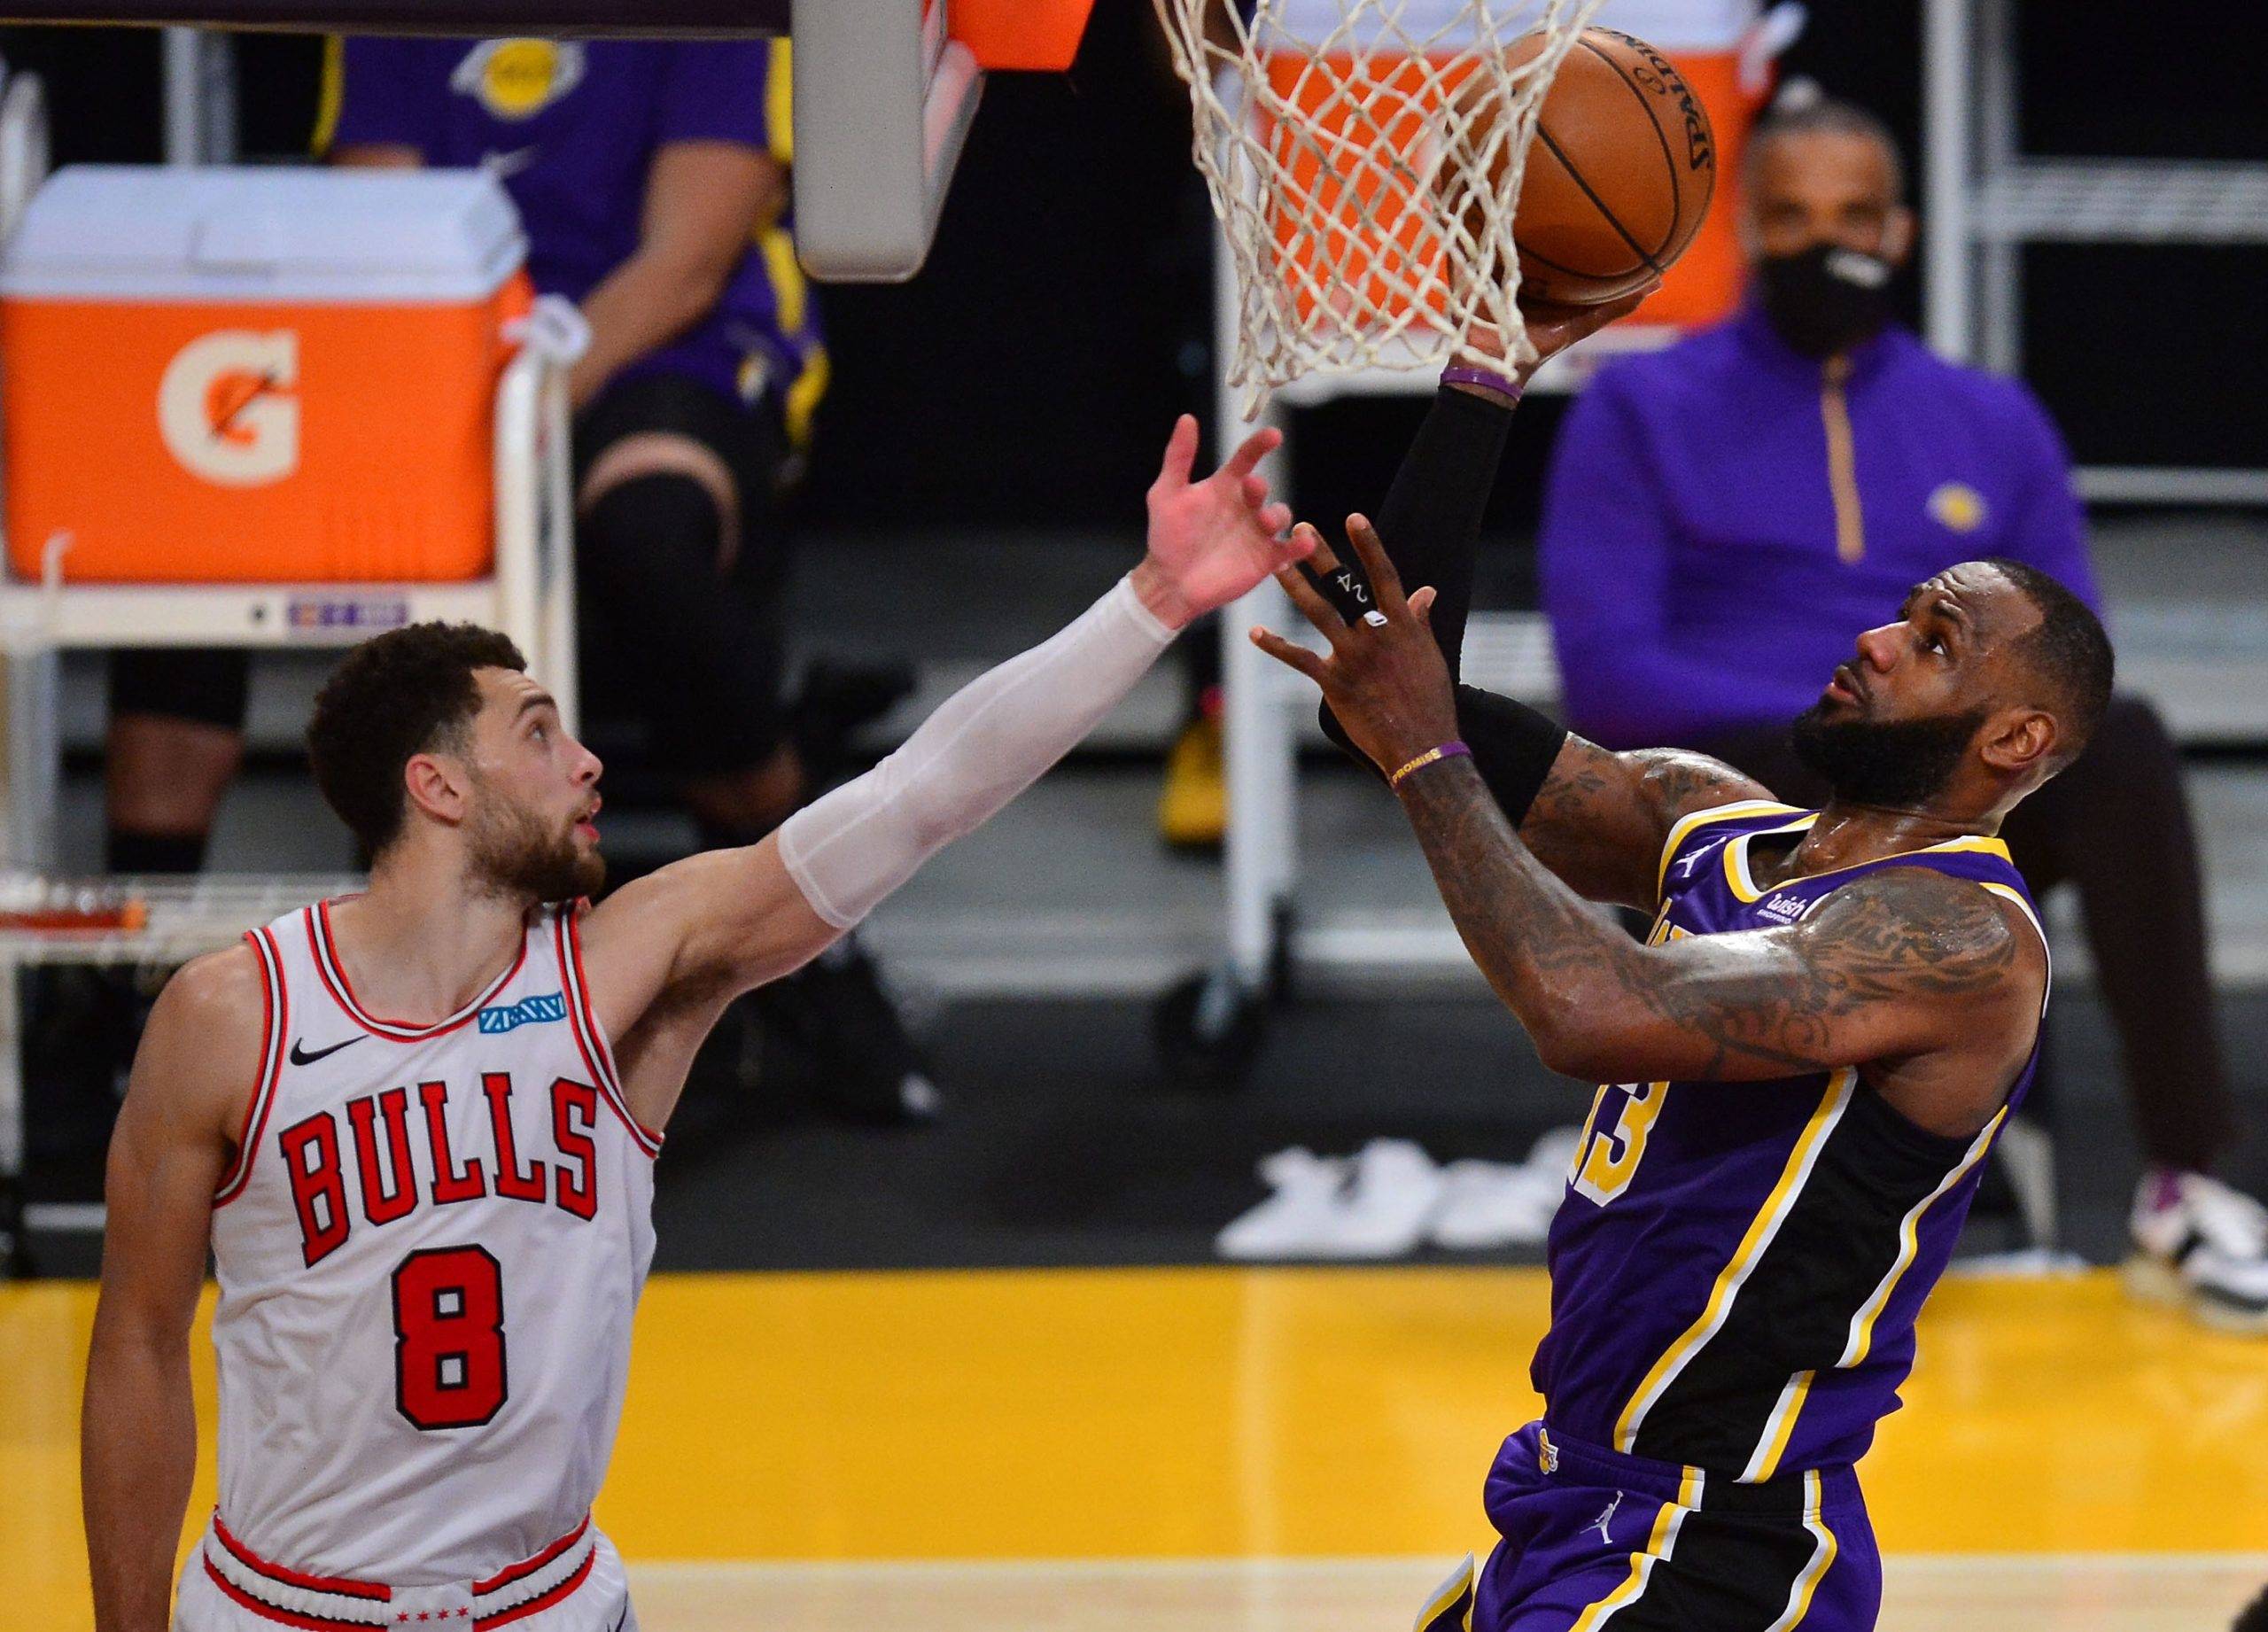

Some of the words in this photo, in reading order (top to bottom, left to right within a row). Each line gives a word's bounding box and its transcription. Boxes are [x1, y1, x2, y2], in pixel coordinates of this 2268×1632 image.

[157, 329, 300, 487] G
[278, 1072, 597, 1270] BULLS
[1567, 1081, 1670, 1208] 3
[391, 1244, 509, 1431] 8
